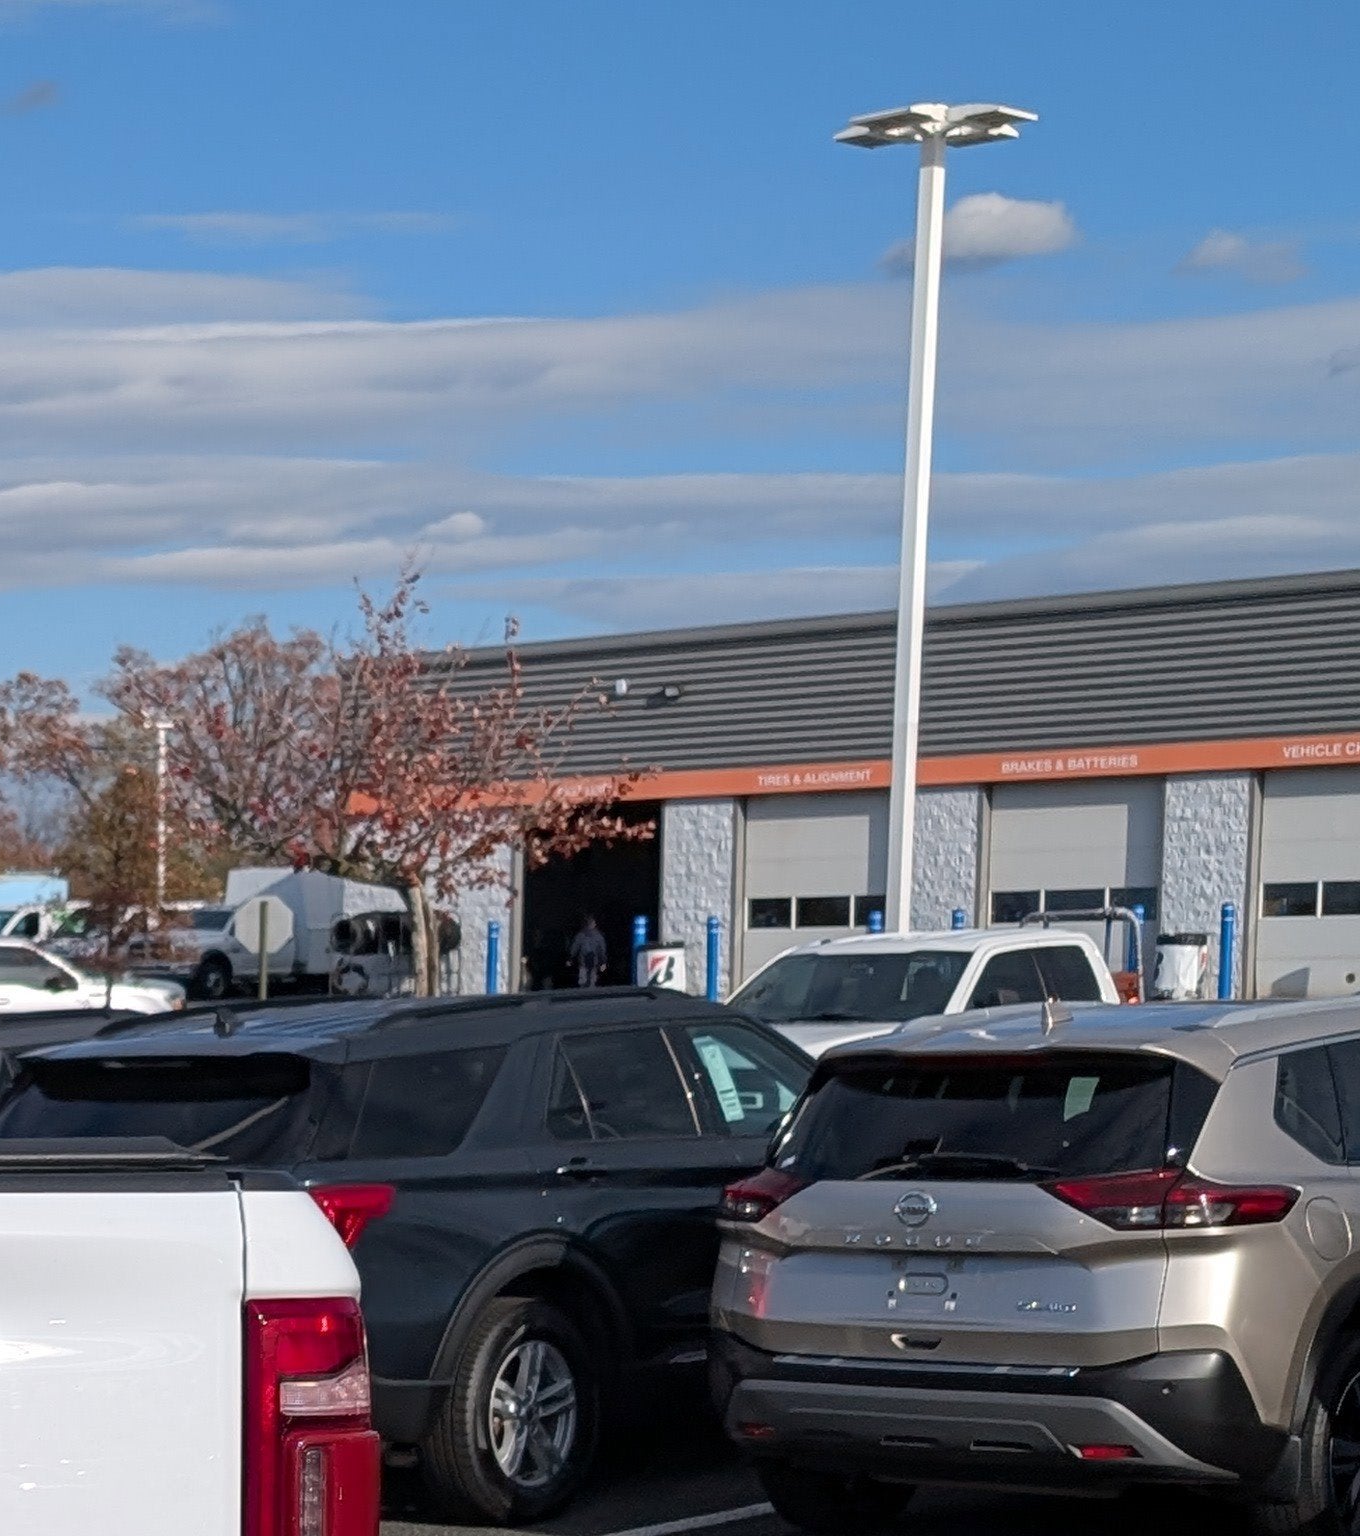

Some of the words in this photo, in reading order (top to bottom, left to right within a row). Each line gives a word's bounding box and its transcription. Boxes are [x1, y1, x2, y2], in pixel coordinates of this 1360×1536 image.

[1282, 743, 1342, 758] VEHICLE
[1001, 758, 1053, 774] BRAKES
[1067, 754, 1138, 771] BATTERIES
[757, 773, 790, 786] TIRES
[803, 769, 872, 784] ALIGNMENT
